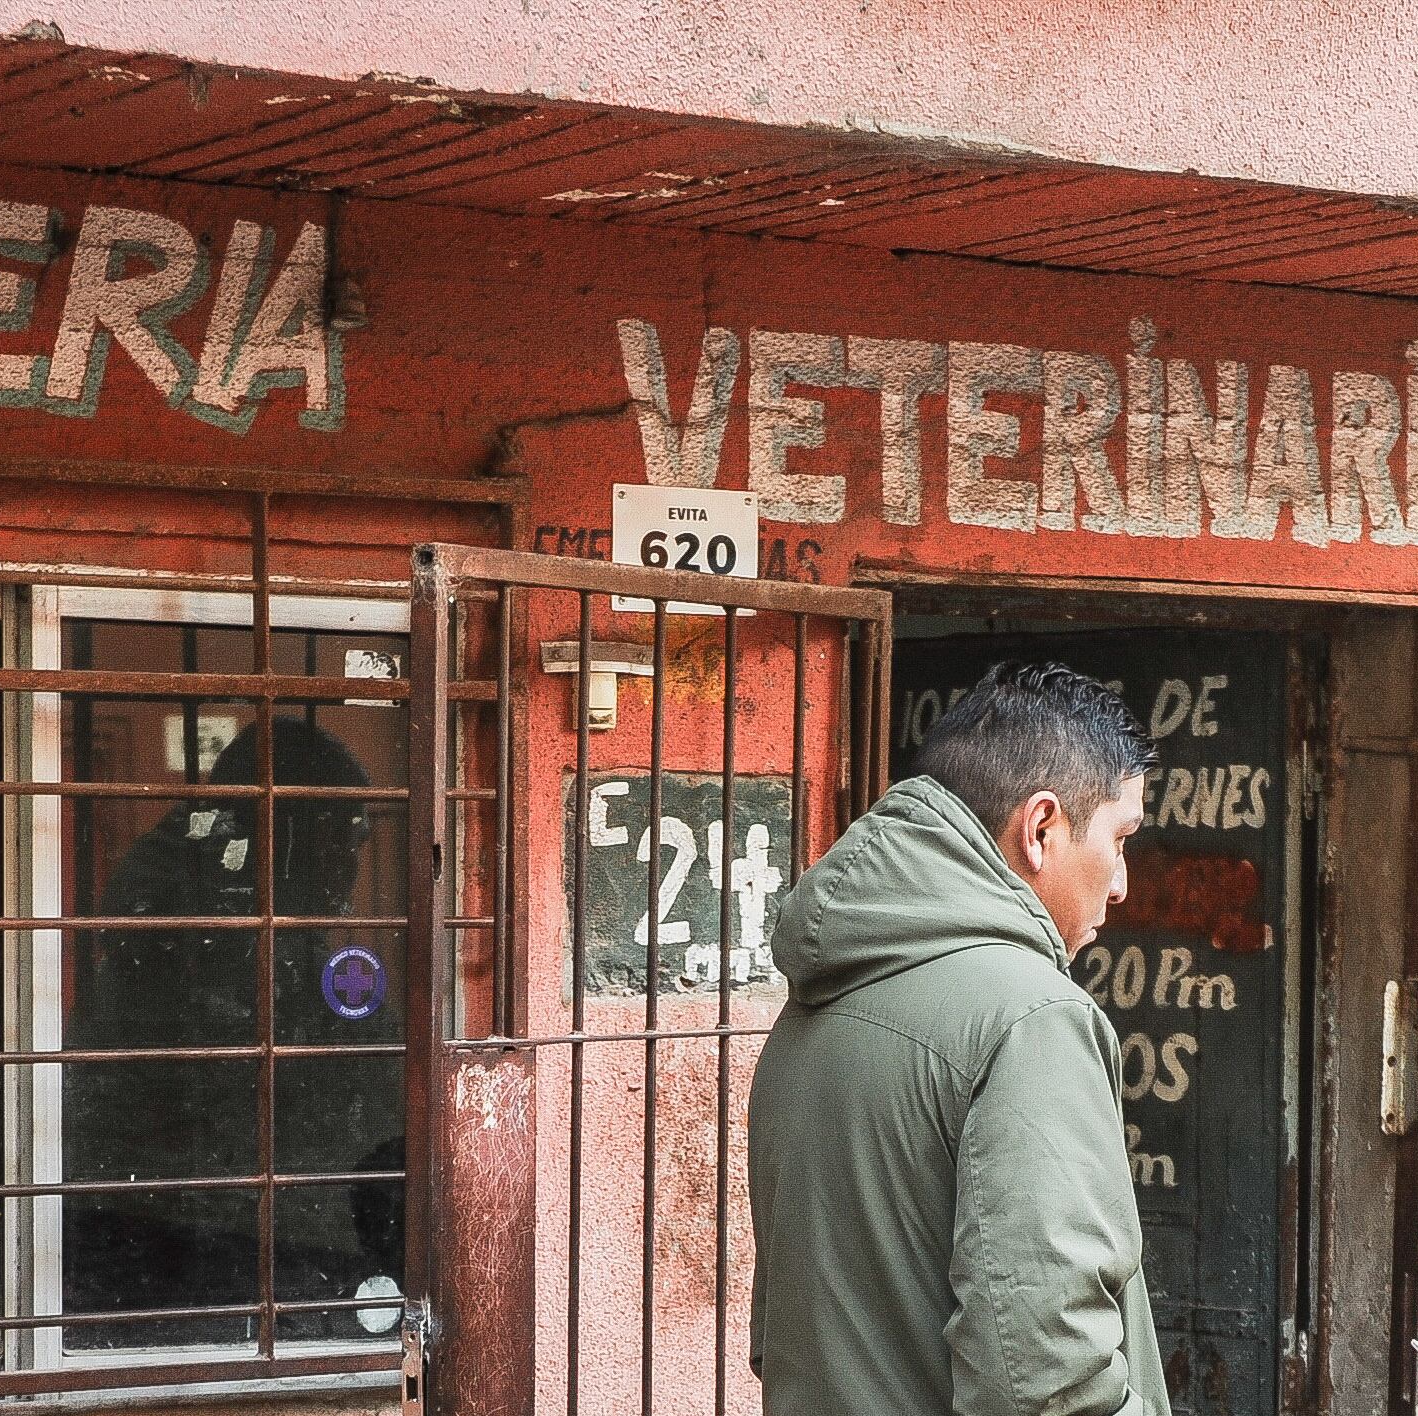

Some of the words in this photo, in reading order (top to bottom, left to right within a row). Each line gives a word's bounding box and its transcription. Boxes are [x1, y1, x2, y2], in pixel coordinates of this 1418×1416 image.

[668, 507, 709, 522] EVITA
[640, 530, 737, 577] 620
[1150, 673, 1228, 739] DE
[1142, 764, 1271, 830] ERNES
